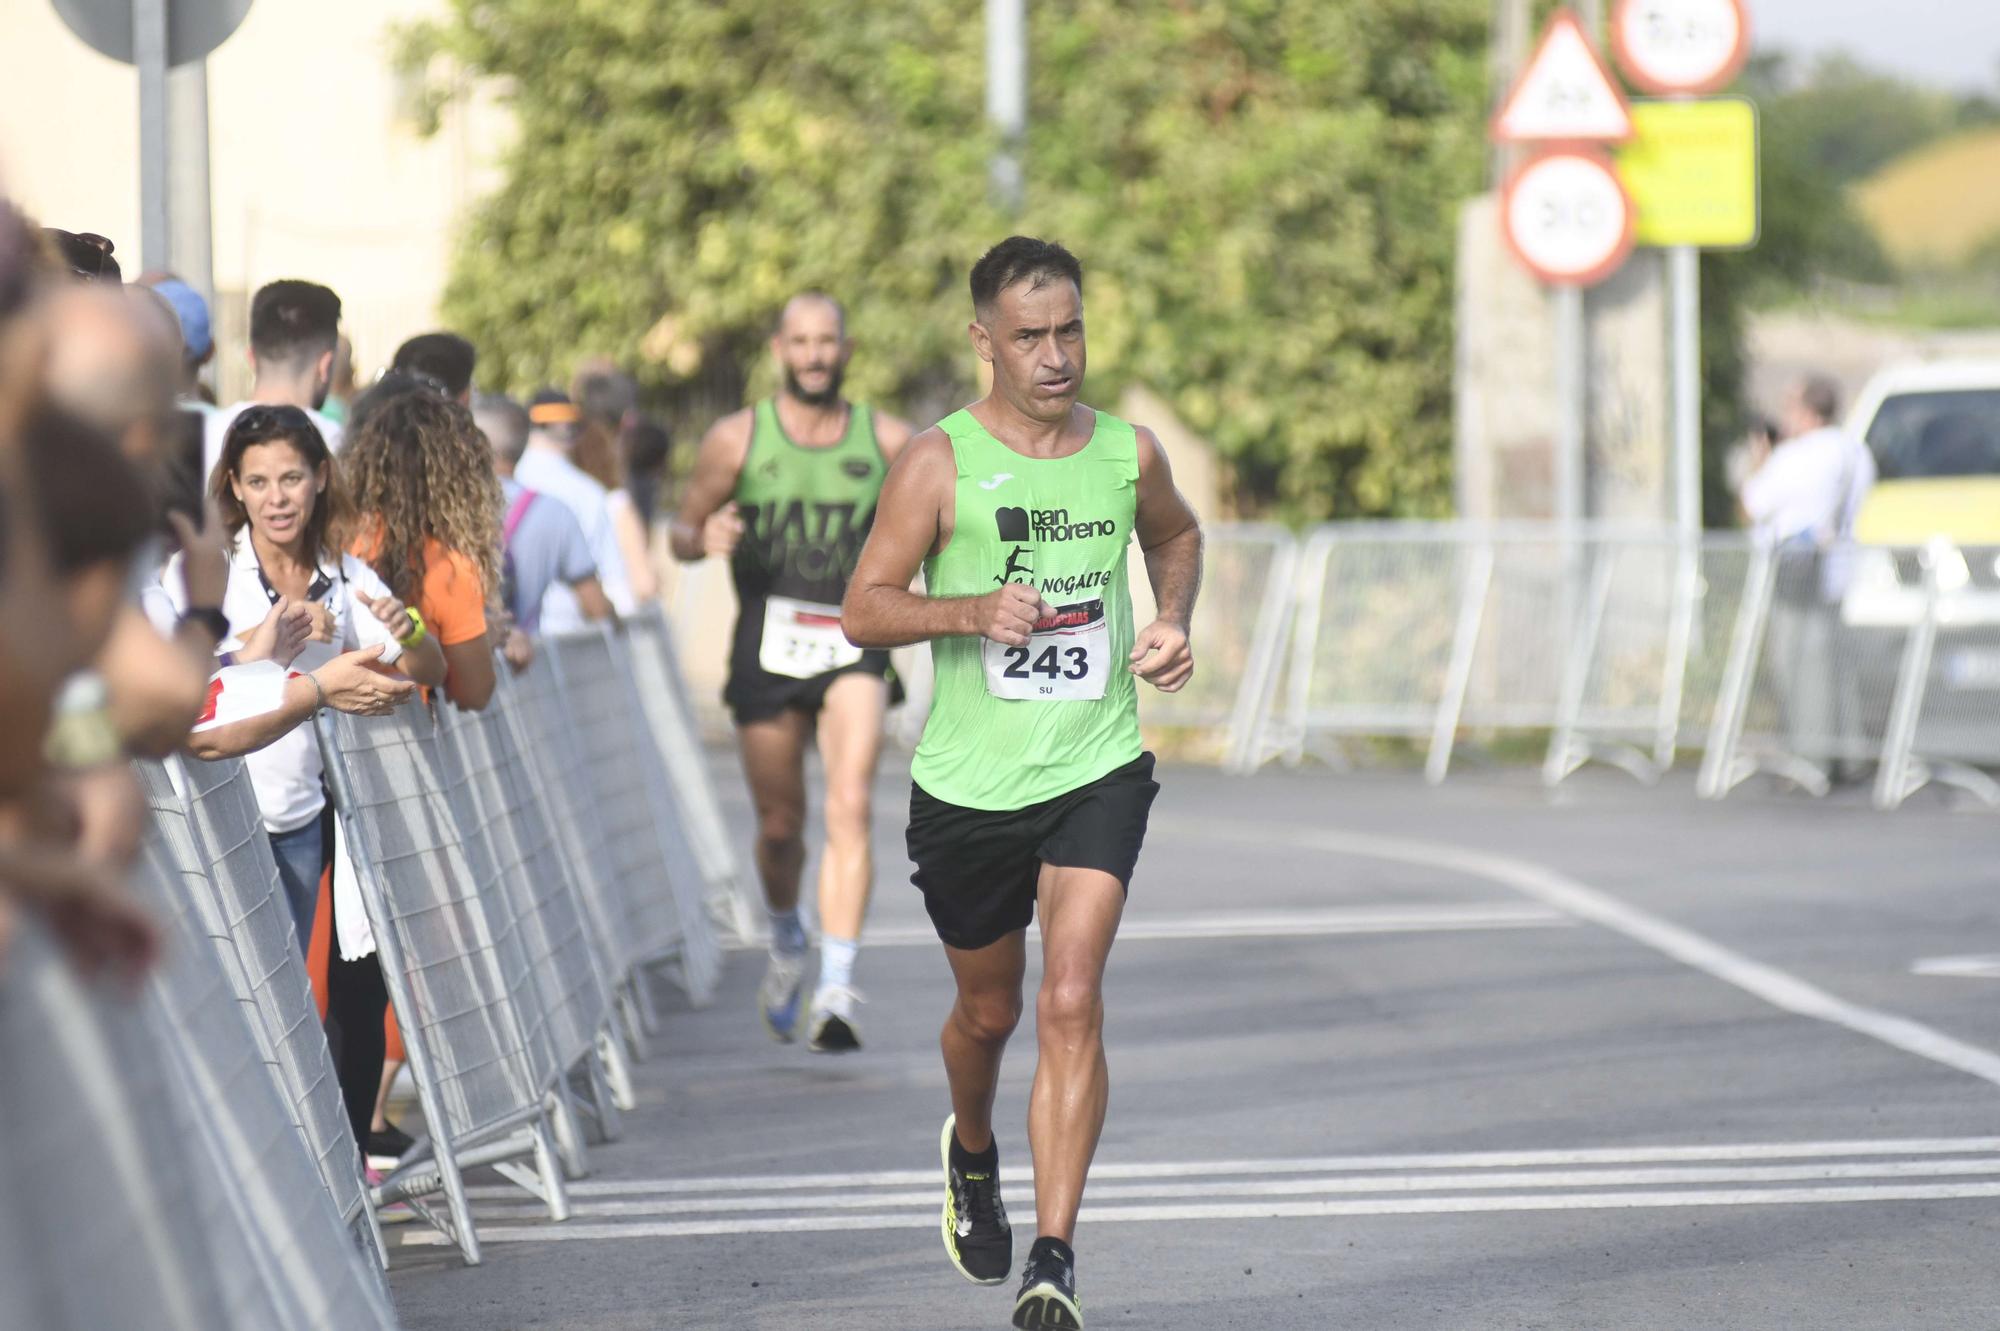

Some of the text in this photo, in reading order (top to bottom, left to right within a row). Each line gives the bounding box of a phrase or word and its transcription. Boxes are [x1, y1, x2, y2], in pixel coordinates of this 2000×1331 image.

[1031, 508, 1068, 530] pan
[1036, 519, 1115, 542] moreno
[1041, 570, 1112, 596] NOGALTE
[1003, 645, 1089, 680] 243
[1039, 686, 1053, 694] SU
